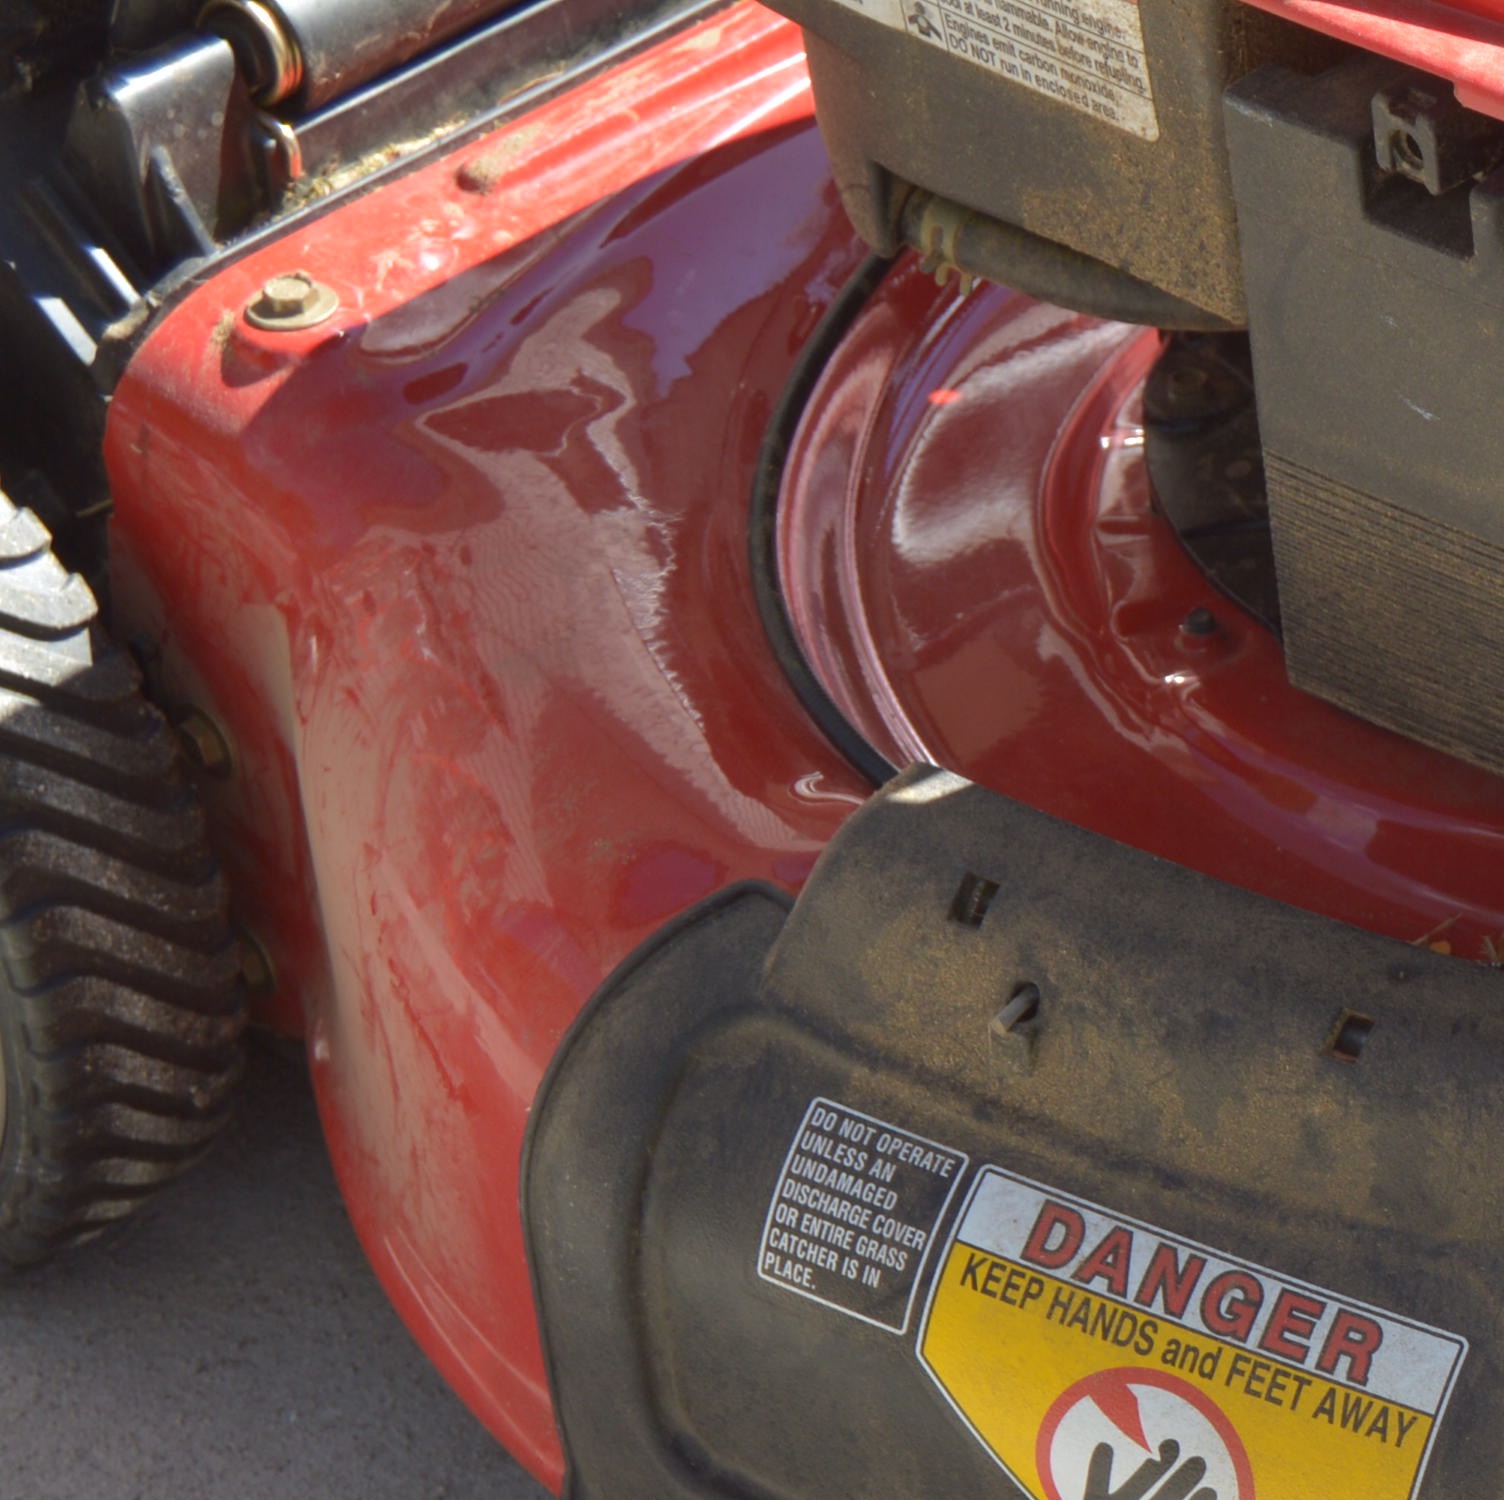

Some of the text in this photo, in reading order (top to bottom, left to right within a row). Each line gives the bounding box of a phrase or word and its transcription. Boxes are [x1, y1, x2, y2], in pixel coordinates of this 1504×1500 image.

[944, 12, 990, 46] Engines
[992, 37, 1017, 58] emit
[1019, 49, 1058, 76] carbon
[975, 3, 1001, 28] least
[1002, 16, 1011, 32] 2
[1013, 23, 1056, 52] minutes
[1056, 40, 1092, 68] before
[1036, 0, 1080, 26] unning
[1055, 21, 1085, 45] Allow
[1086, 37, 1125, 63] engine
[1126, 51, 1139, 68] to
[949, 32, 968, 54] DO
[970, 42, 996, 67] NOT
[1000, 58, 1020, 77] run
[1020, 63, 1033, 82] in
[1035, 74, 1089, 108] enclosed
[801, 1130, 897, 1183] UNLESS AN
[811, 1107, 956, 1178] DO NOT OPERATE
[791, 1154, 898, 1210] UNDAMAGED
[775, 1203, 908, 1271] OR ENTIRE GRASS
[782, 1178, 927, 1251] DISCHARGE COVER
[764, 1252, 816, 1290] PLACE.
[769, 1228, 881, 1288] CATCHER IS IN
[1019, 1199, 1383, 1387] DANGER
[960, 1252, 1418, 1448] KEEP HANDS and FEET AWAY
